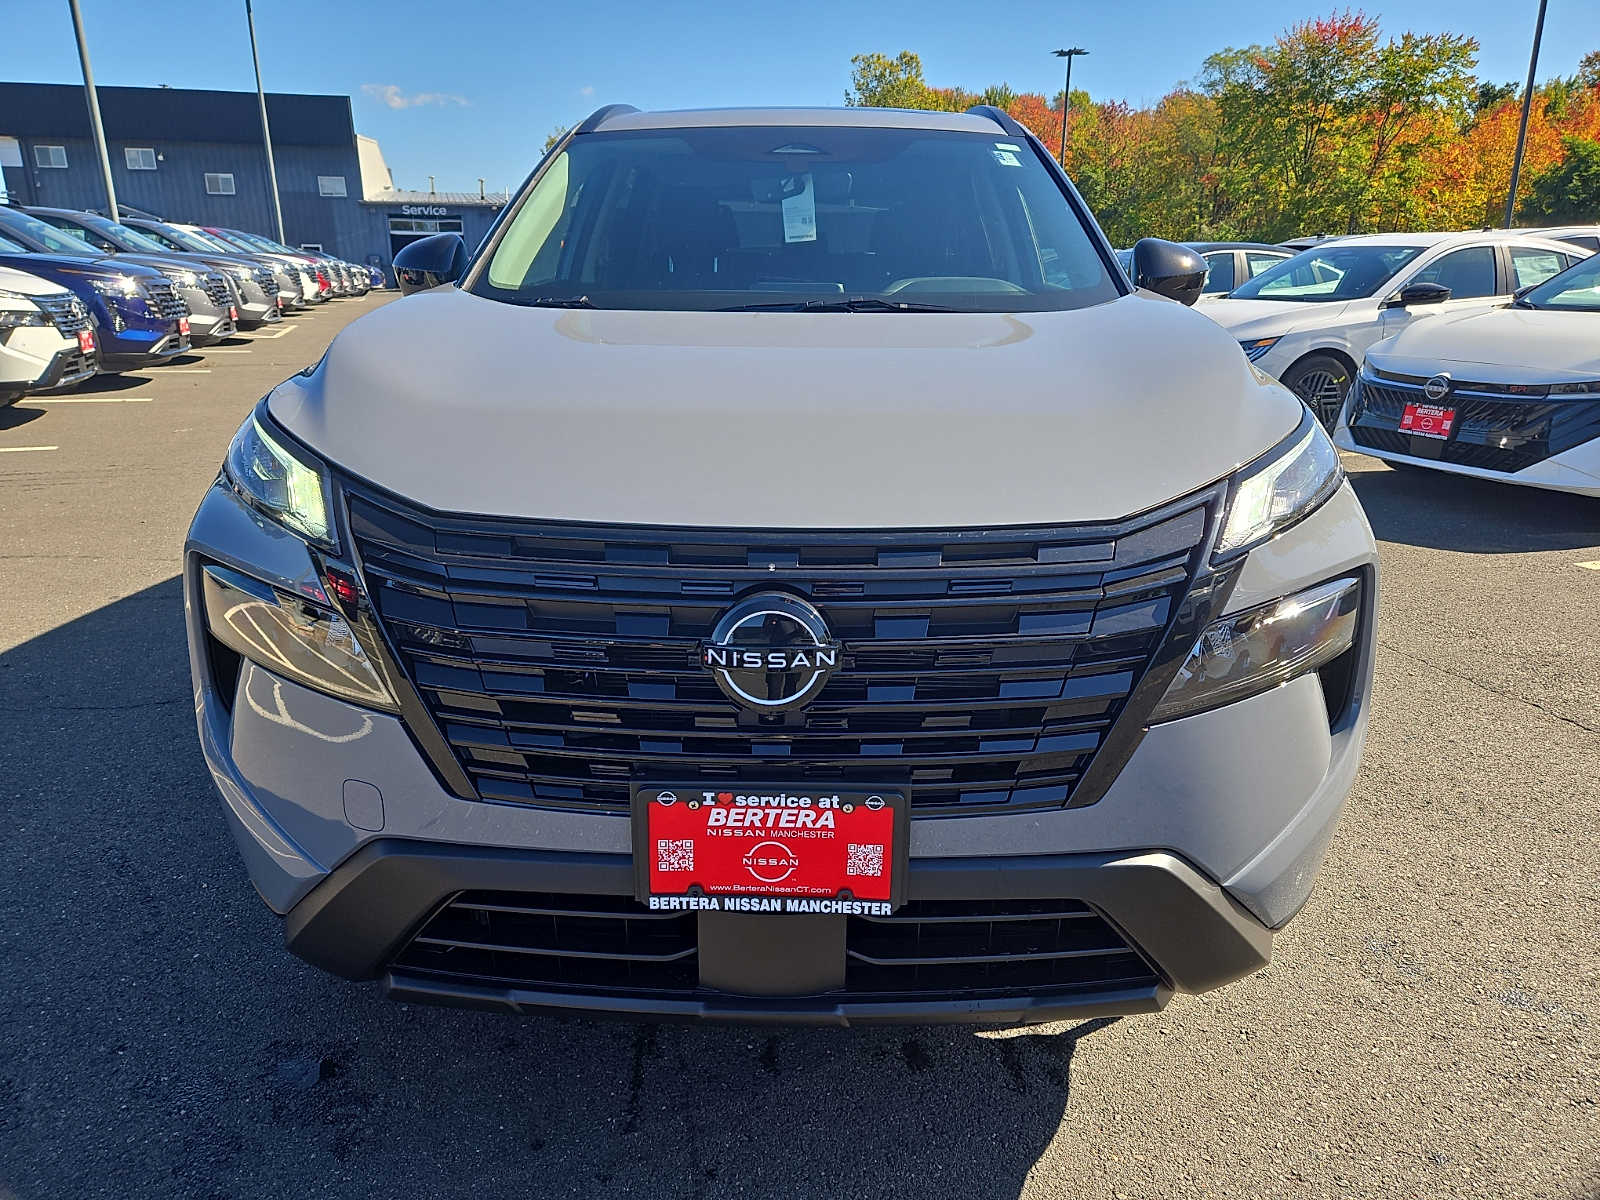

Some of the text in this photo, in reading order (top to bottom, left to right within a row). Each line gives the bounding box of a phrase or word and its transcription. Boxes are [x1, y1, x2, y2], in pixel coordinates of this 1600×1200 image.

[402, 205, 447, 215] Service
[707, 648, 835, 668] NISSAN
[702, 792, 840, 809] I service at
[707, 808, 835, 829] BERTERA
[707, 828, 835, 839] NISSAN MANCHESTER
[742, 857, 799, 866] NISSAN
[709, 884, 832, 893] www.BerteraNissanCT.com
[649, 897, 892, 915] BERTERA NISSAN MANCHESTER
